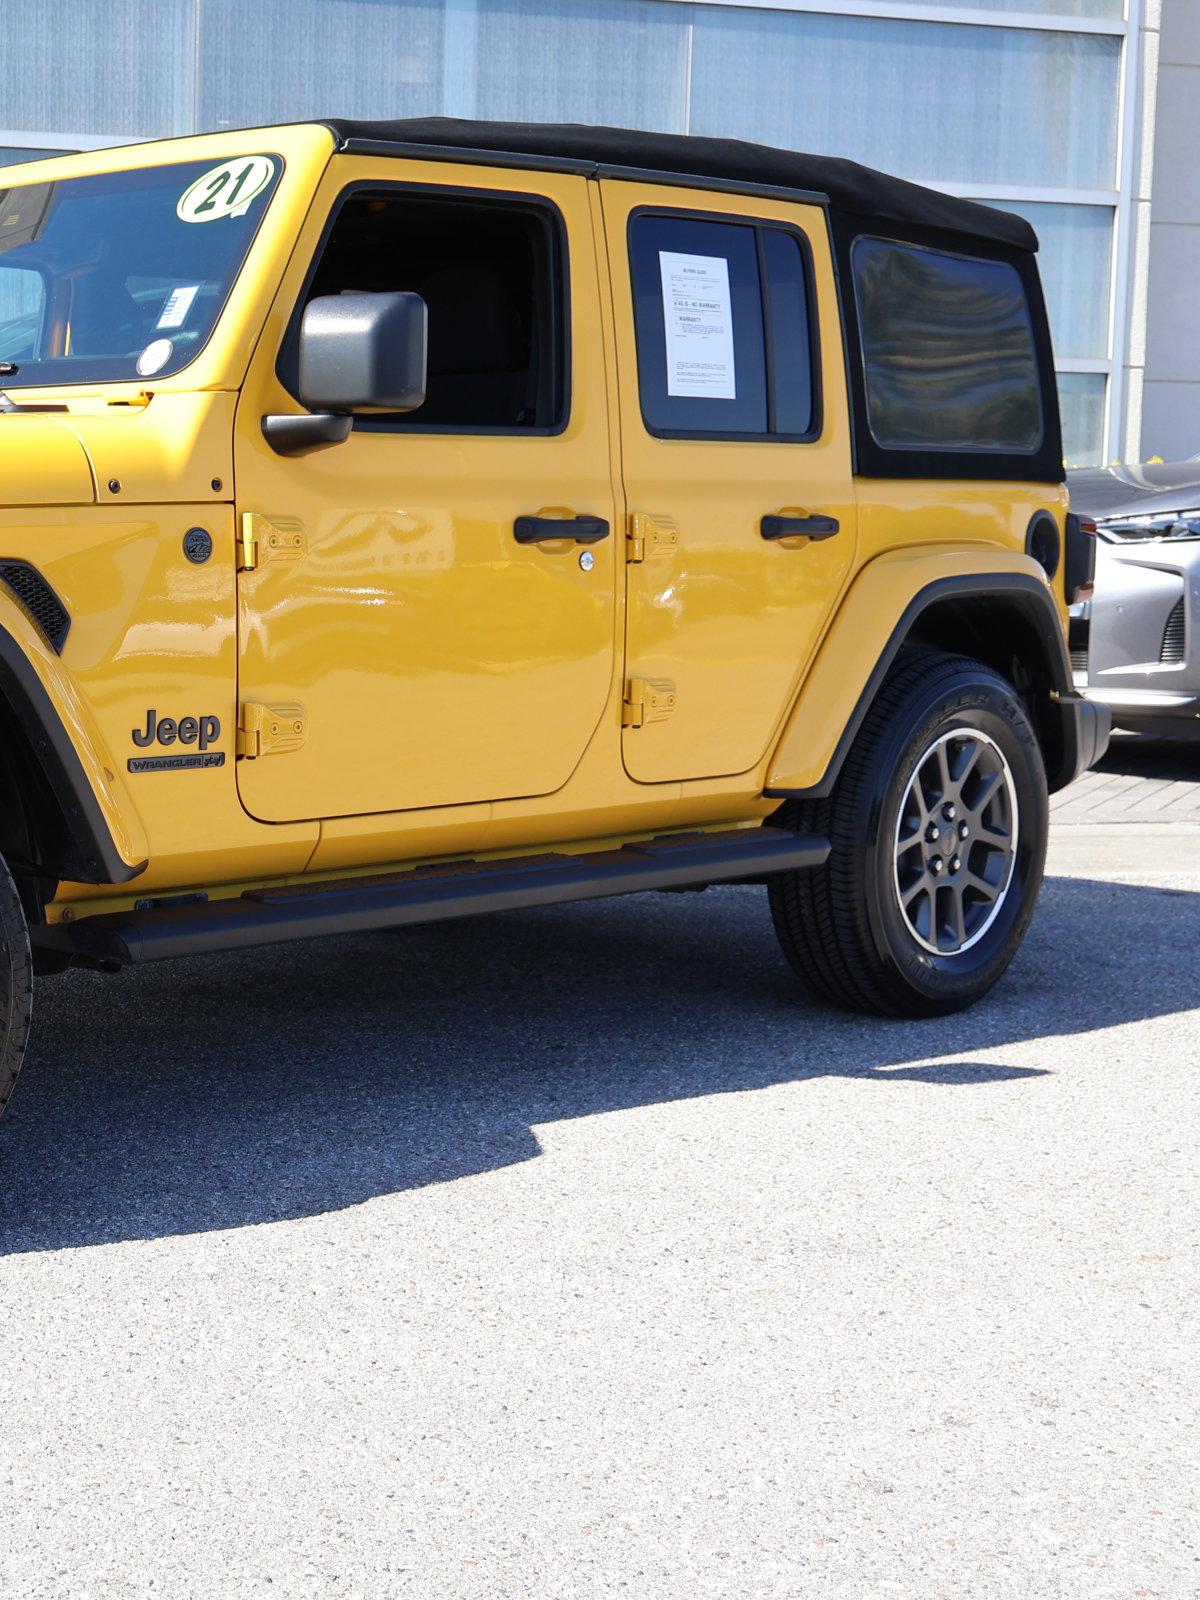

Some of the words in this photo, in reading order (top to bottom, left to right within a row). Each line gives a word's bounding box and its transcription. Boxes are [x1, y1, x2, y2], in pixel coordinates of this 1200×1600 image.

[194, 163, 255, 215] 21
[132, 709, 221, 750] Jeep
[132, 757, 202, 770] WRANGLER
